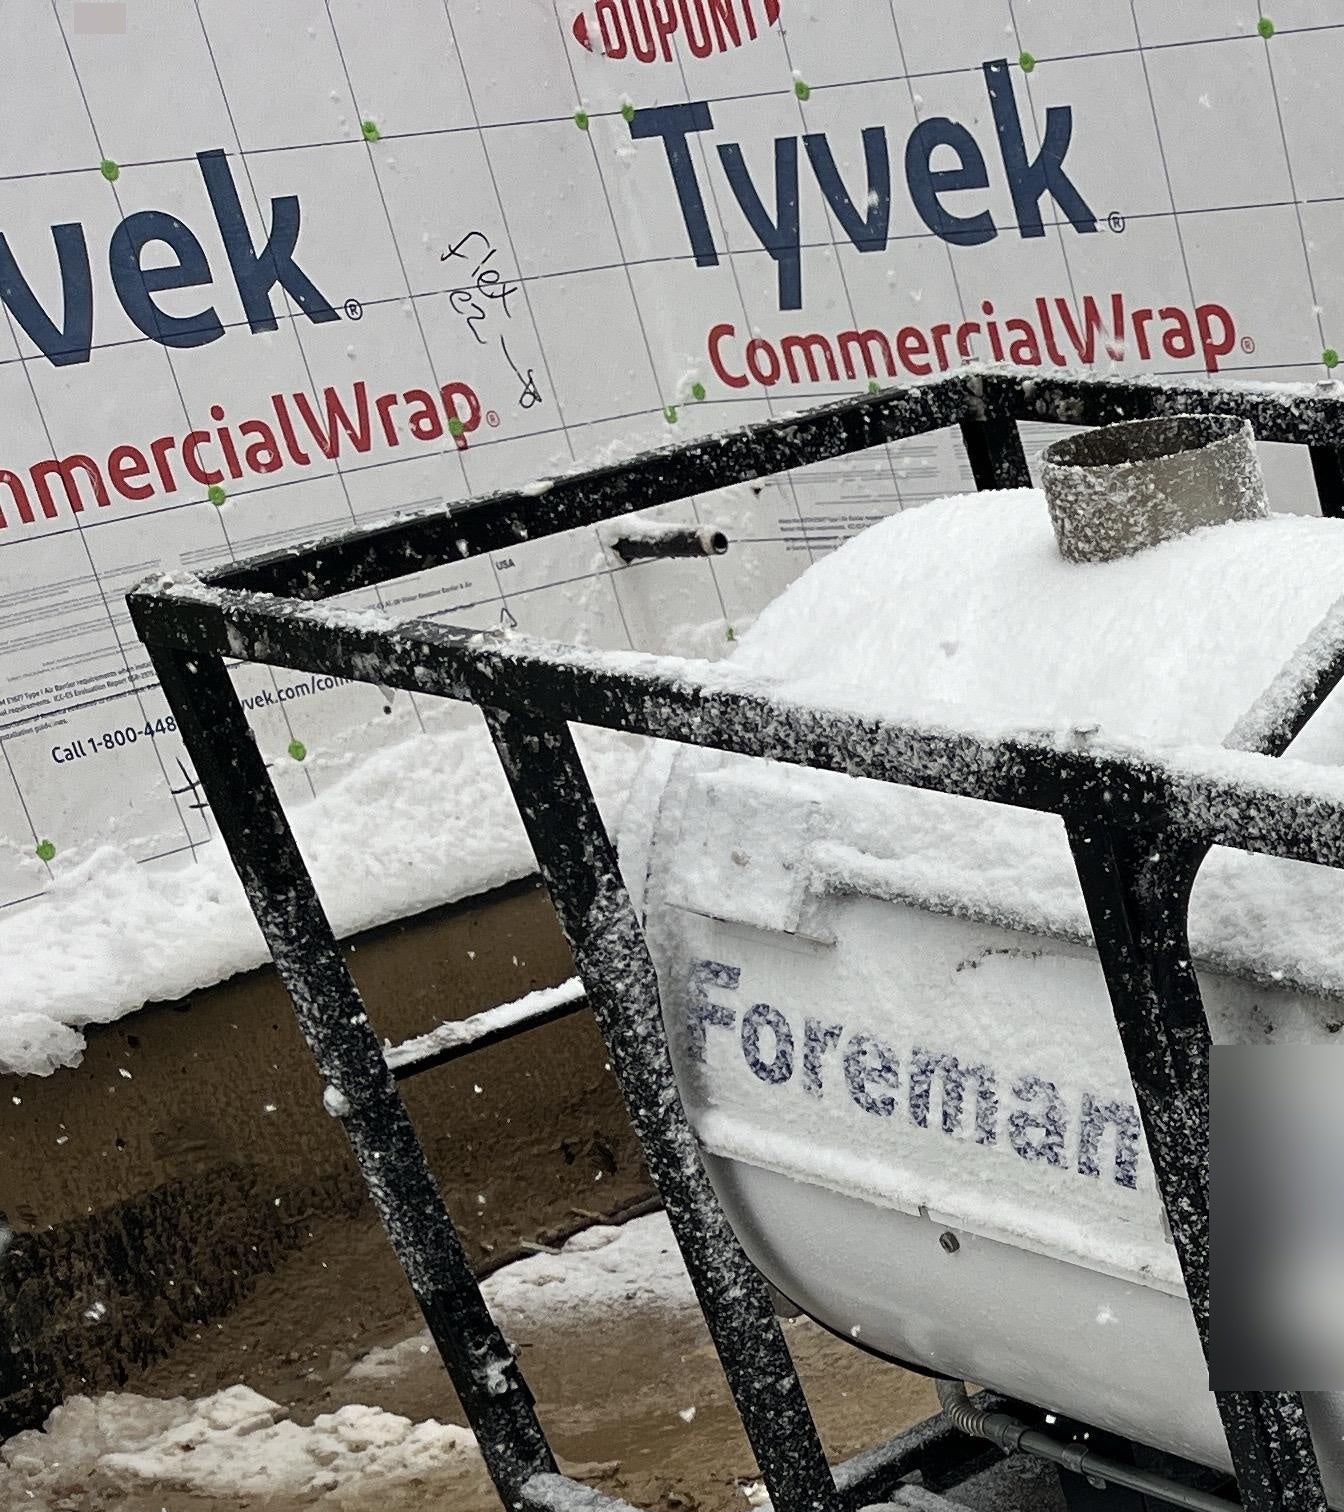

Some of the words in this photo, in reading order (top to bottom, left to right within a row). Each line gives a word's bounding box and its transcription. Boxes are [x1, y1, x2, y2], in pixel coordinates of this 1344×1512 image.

[630, 58, 1098, 311] Tyvek
[707, 293, 1236, 389] CommercialWrap
[496, 558, 516, 571] USA
[51, 741, 87, 764] Call
[687, 958, 1142, 1190] Foreman
